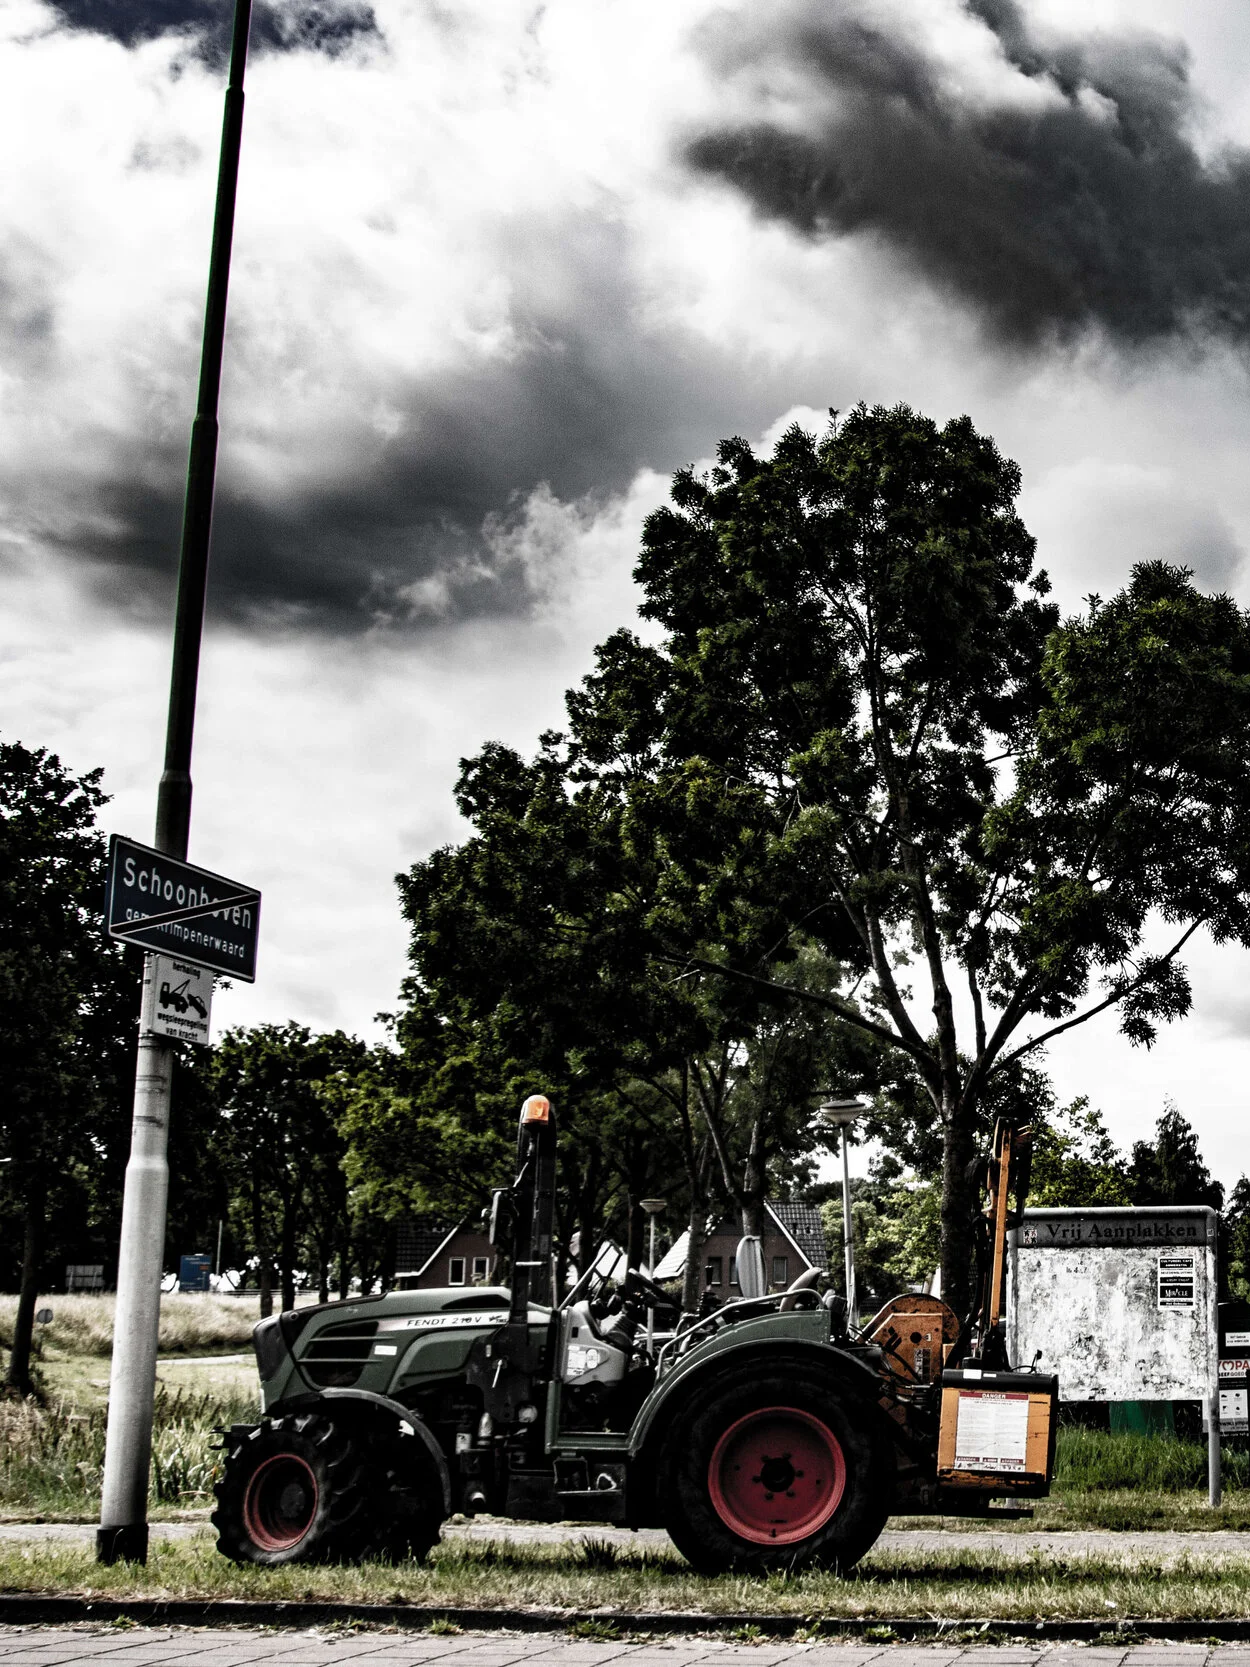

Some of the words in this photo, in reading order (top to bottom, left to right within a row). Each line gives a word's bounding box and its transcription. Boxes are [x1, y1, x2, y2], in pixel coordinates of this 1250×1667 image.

[157, 1012, 208, 1033] wegsleepregeling
[166, 1027, 177, 1036] van
[179, 1029, 198, 1041] kracht
[1045, 1223, 1081, 1241] Vrij
[1088, 1222, 1197, 1240] Aanplakken
[407, 1318, 447, 1327] FENDT
